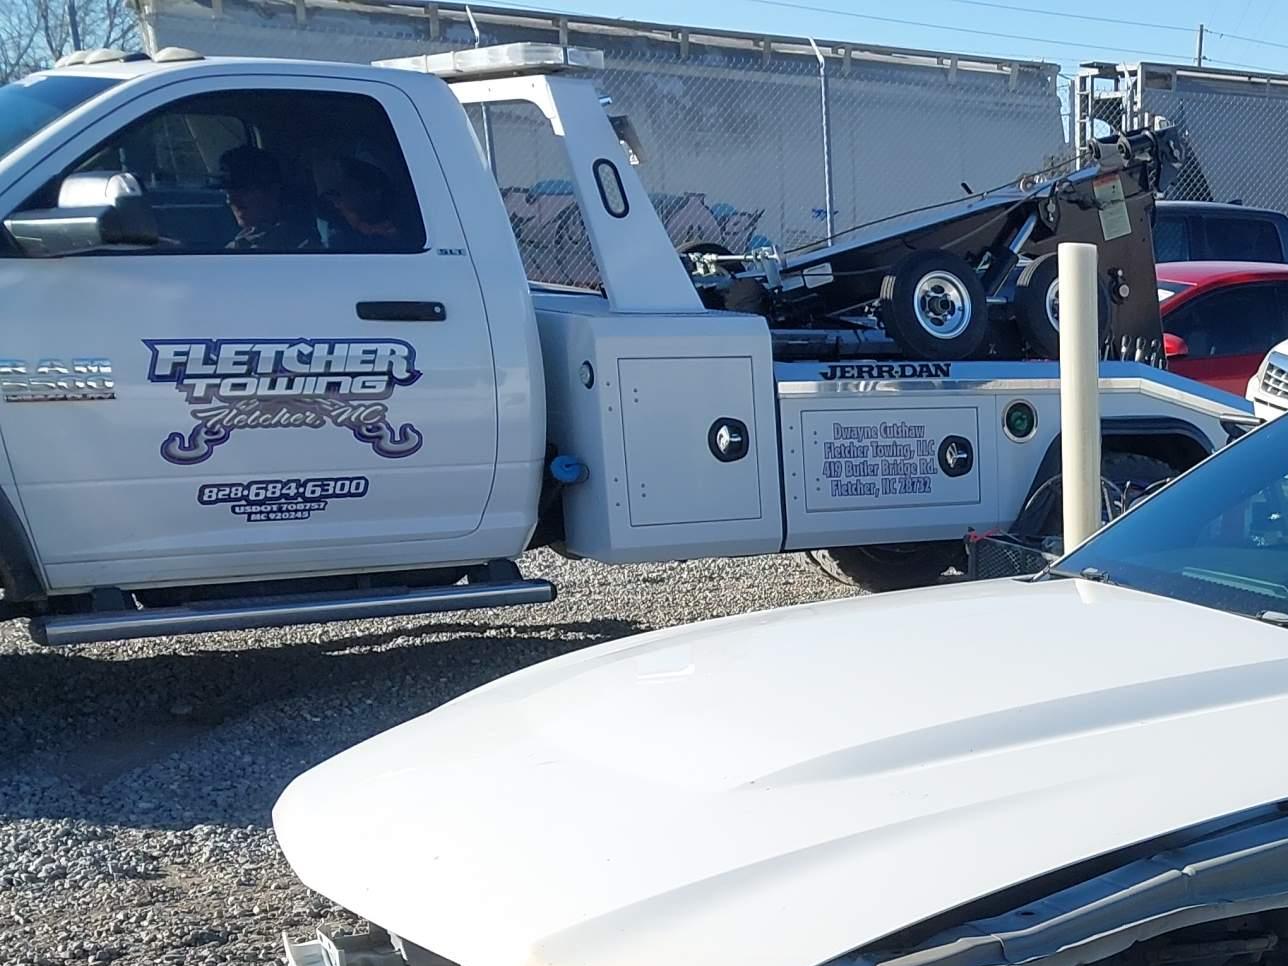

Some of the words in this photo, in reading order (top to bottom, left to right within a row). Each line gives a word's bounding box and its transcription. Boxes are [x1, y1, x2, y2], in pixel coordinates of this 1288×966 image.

[437, 248, 466, 256] SLT
[152, 341, 416, 380] FLETCHER
[183, 376, 389, 398] TOWING
[197, 405, 322, 429] Fletcher,
[331, 405, 384, 424] NC
[832, 422, 879, 442] Dwayne
[880, 421, 926, 439] Cutshaw
[824, 441, 870, 459] Fletcher
[870, 440, 916, 461] Towing,
[916, 439, 936, 457] LLC
[822, 460, 842, 478] 419
[844, 460, 880, 478] Butler
[880, 459, 918, 478] Bridge
[919, 458, 938, 475] Rd.
[831, 479, 880, 498] Fletcher,
[881, 477, 897, 496] NC
[898, 477, 932, 494] 28732
[235, 505, 278, 513] USDOT
[250, 513, 267, 521] MC
